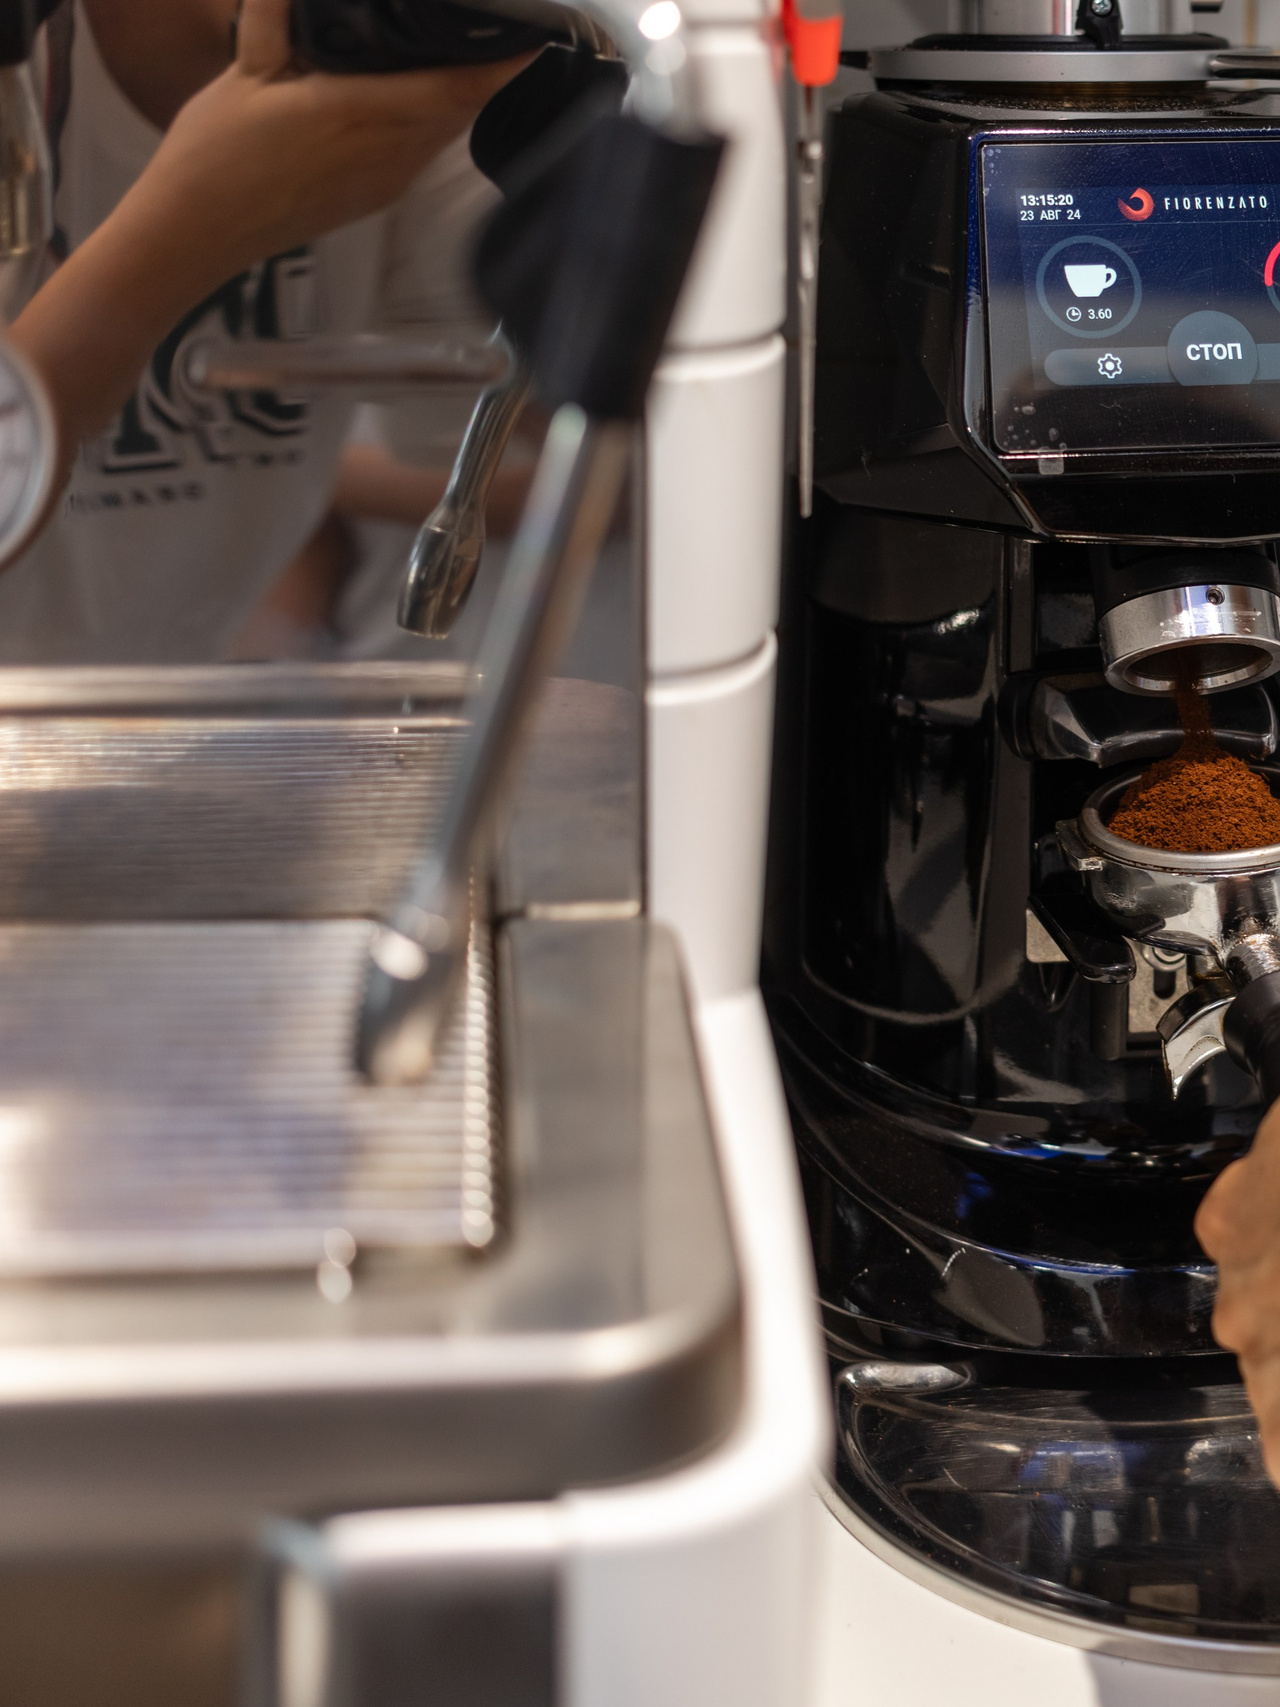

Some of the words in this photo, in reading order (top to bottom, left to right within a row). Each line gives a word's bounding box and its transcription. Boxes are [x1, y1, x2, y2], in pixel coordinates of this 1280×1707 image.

[1020, 194, 1074, 206] 13:15:20
[1164, 196, 1268, 210] FIORENZATO
[1020, 210, 1034, 221] 23
[1040, 209, 1061, 220] АВГ
[1066, 209, 1081, 220] 24
[1088, 308, 1112, 319] 3.60
[1186, 342, 1243, 361] СТОП
